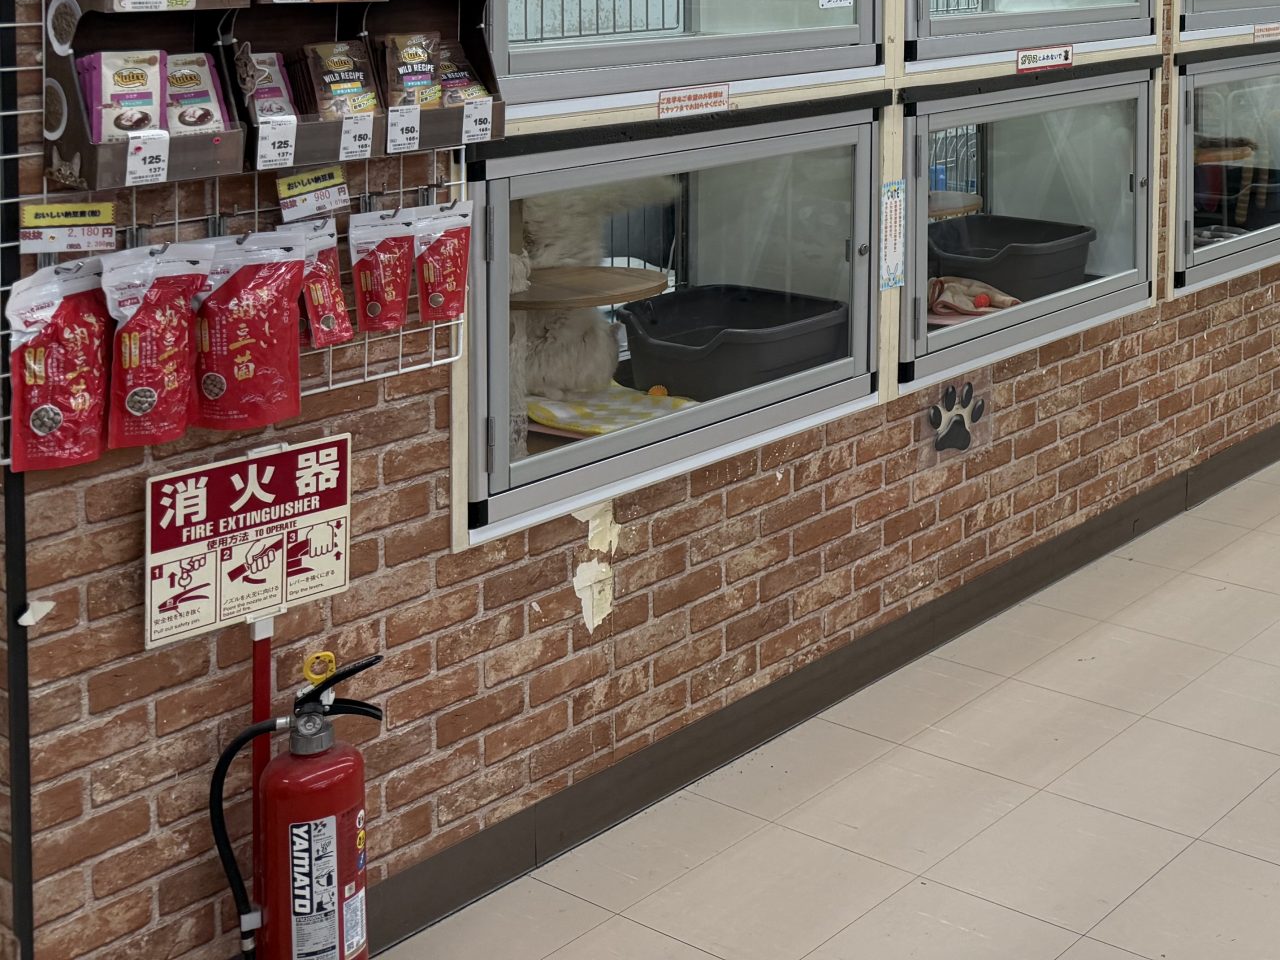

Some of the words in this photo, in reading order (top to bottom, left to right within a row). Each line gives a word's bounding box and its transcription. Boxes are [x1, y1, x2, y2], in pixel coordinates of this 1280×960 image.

[398, 65, 412, 74] WILD
[413, 64, 434, 72] RECIPE
[448, 71, 470, 79] RECIPE
[113, 71, 148, 87] Nutro
[168, 72, 201, 87] Nutro
[323, 73, 340, 83] WILD
[341, 71, 364, 80] RECIPE
[314, 190, 331, 202] 980
[338, 186, 347, 196] 円
[102, 228, 113, 238] 円
[159, 447, 340, 529] 消火器
[182, 522, 214, 542] FIRE
[219, 495, 320, 533] EXTINGUISHER
[254, 528, 264, 538] TO
[266, 520, 297, 536] OPERATE
[206, 532, 250, 550] 使用方法
[289, 532, 296, 542] 3
[223, 550, 230, 559] 2
[154, 568, 160, 578] 1
[223, 604, 236, 612] Point
[246, 597, 263, 606] nozzle
[154, 607, 201, 626] 安全栓を引き抜く
[153, 628, 164, 636] Pull
[174, 621, 190, 631] safety
[292, 824, 312, 914] YAMATO
